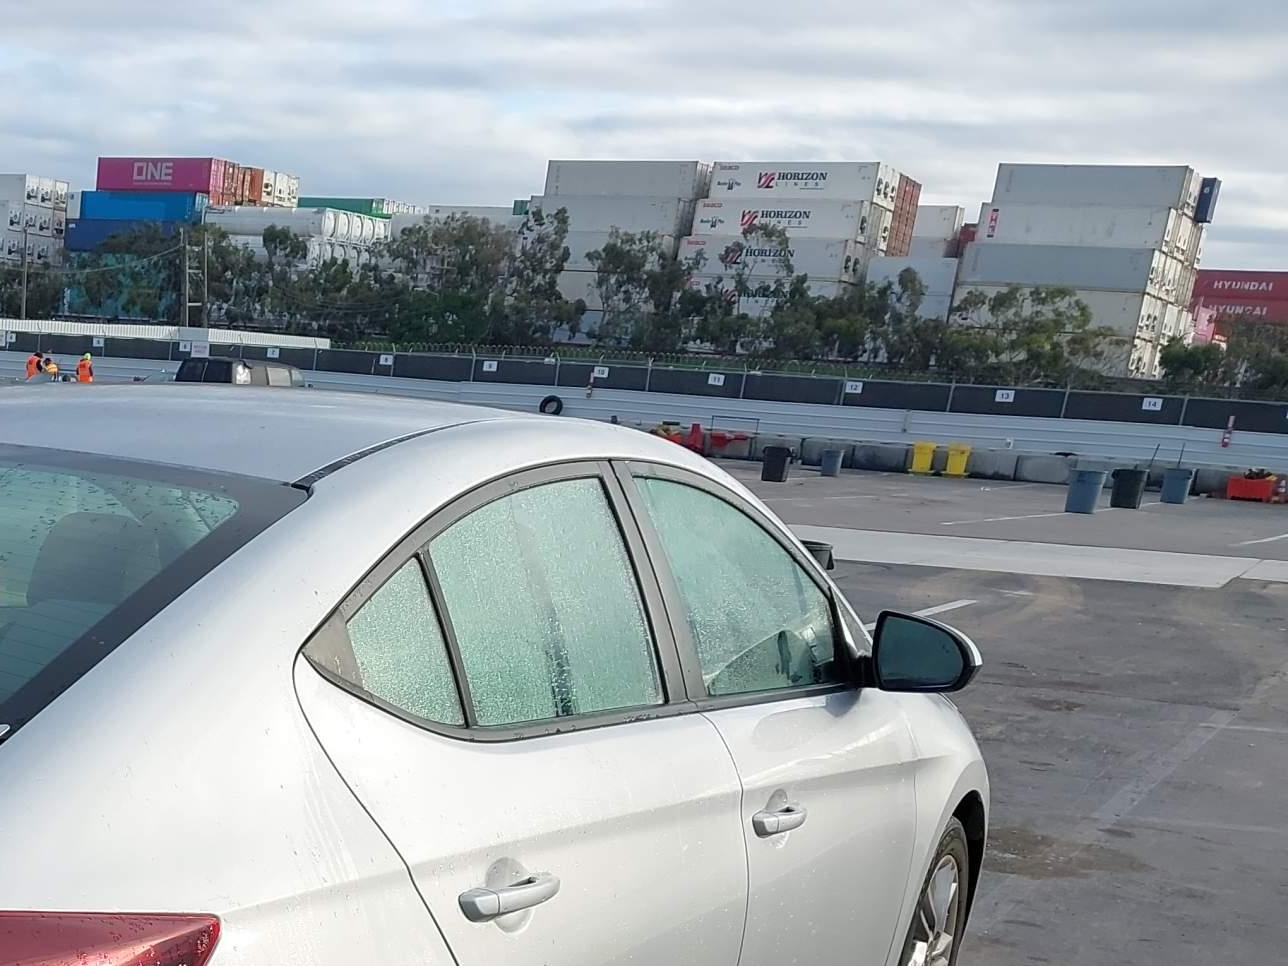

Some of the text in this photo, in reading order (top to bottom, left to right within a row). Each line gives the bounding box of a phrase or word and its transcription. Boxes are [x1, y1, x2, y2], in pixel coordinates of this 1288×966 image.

[133, 161, 173, 181] ONE
[776, 172, 828, 181] HORIZON
[760, 210, 811, 219] HORIZON
[745, 248, 795, 258] HORIZON
[1213, 280, 1274, 292] HYUNDAI
